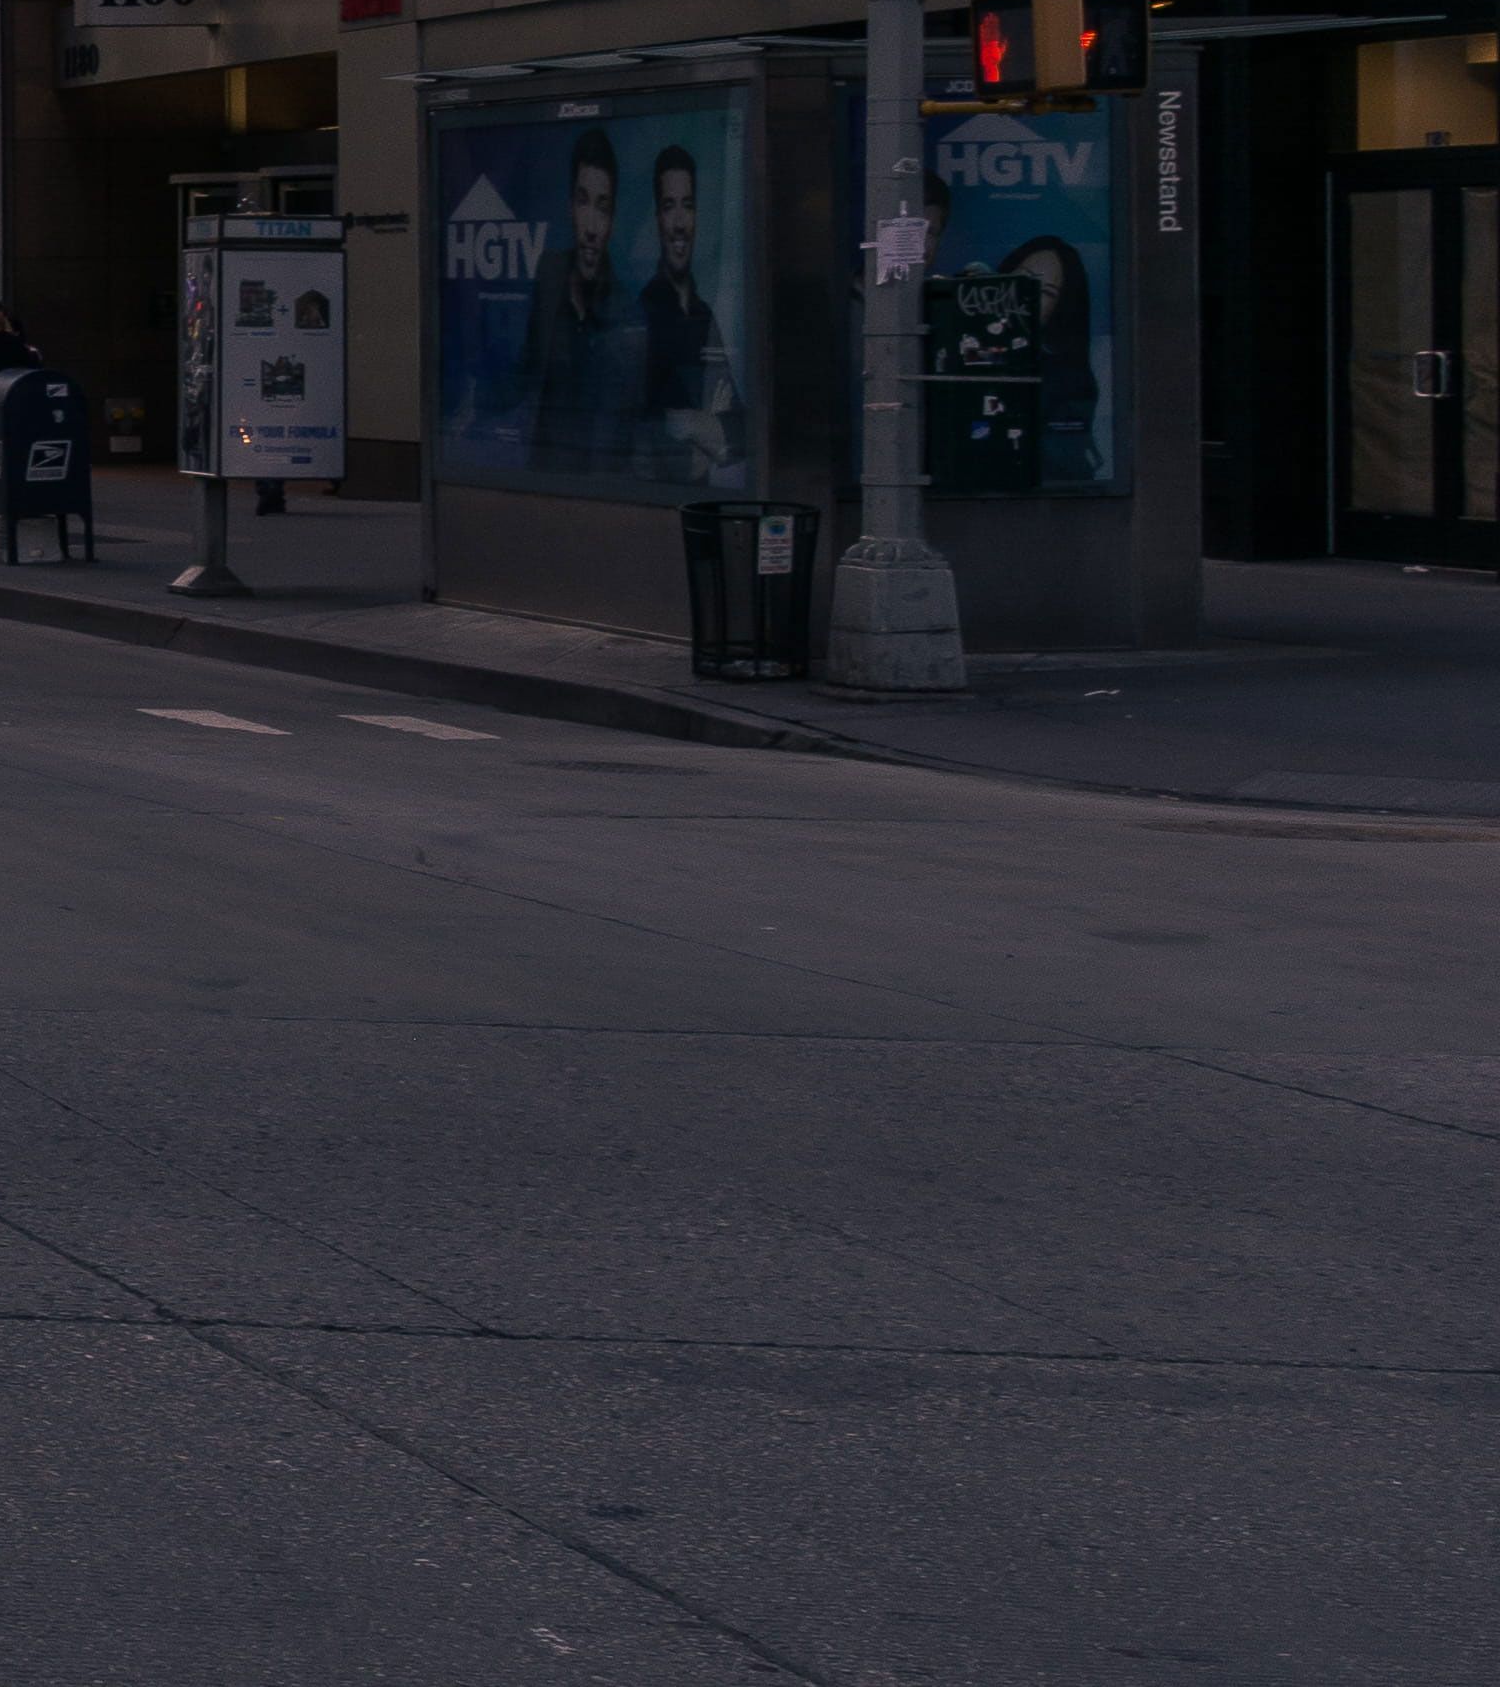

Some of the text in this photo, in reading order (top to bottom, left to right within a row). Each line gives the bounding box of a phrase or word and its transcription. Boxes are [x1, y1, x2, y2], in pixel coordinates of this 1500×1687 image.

[63, 44, 99, 80] 1180
[936, 141, 1096, 187] HGTV
[1158, 90, 1184, 232] Newsstand
[255, 222, 313, 237] TITAN
[446, 221, 549, 280] HGTV
